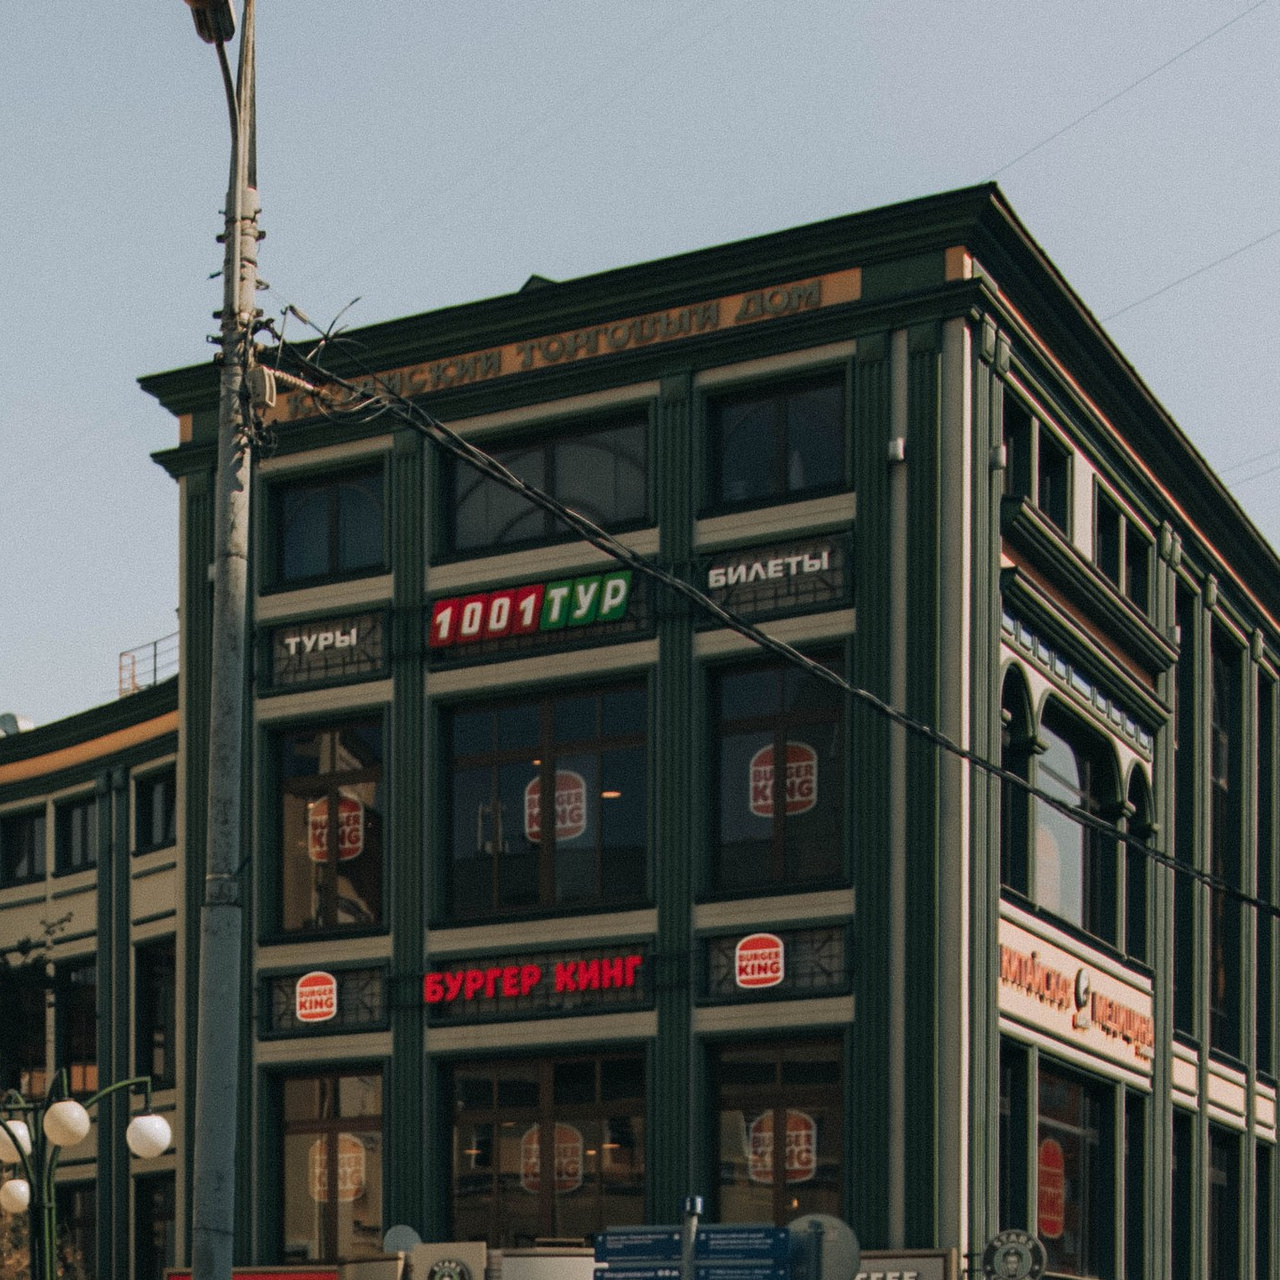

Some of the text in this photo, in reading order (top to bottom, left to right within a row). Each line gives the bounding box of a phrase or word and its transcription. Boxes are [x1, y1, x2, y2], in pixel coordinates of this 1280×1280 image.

[735, 278, 823, 324] ДОМ
[707, 550, 830, 589] БИЛЕТЫ
[283, 627, 358, 656] ТУРЫ
[738, 951, 780, 962] BURGER
[738, 961, 780, 977] KING
[423, 954, 643, 1004] БУРГЕР КИНГ
[299, 987, 334, 998] BURGER
[298, 997, 334, 1011] KING
[993, 1233, 1036, 1249] STARS
